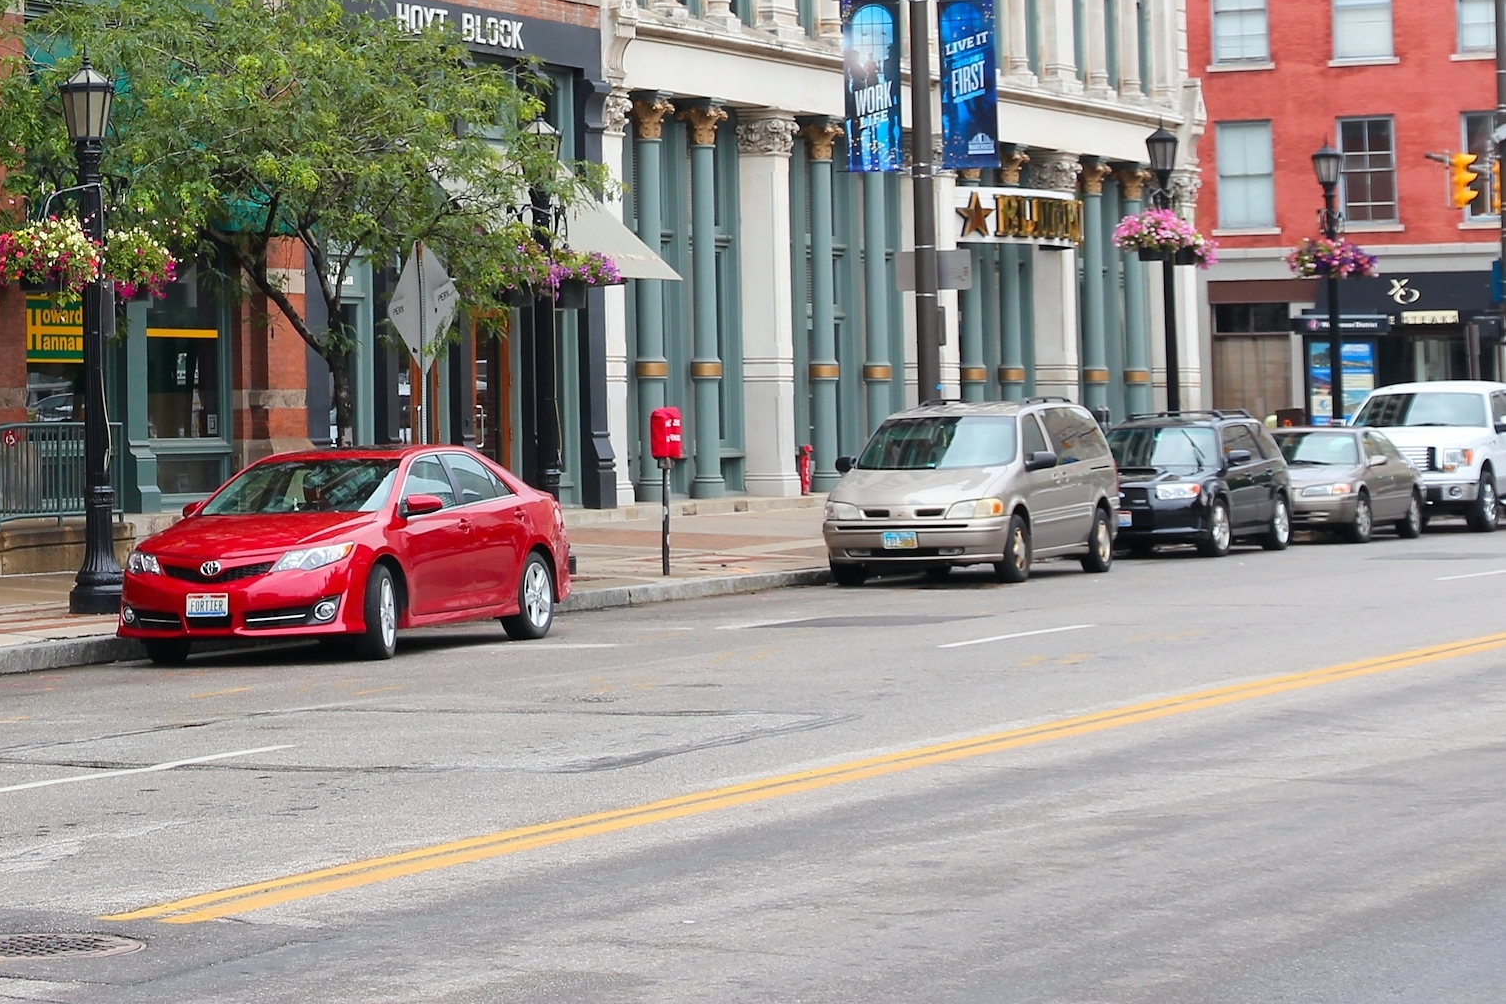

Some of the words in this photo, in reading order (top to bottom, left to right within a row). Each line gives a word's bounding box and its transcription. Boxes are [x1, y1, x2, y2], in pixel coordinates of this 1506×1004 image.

[396, 2, 449, 36] HOYT
[461, 12, 525, 51] BLOCK
[945, 36, 975, 56] LIVE
[976, 30, 989, 45] IT
[951, 60, 986, 98] FIRST
[854, 80, 892, 117] WORK
[859, 109, 889, 130] LIFE
[1387, 278, 1421, 305] XO
[1321, 321, 1355, 329] Waouse
[1403, 313, 1460, 325] STEAKS
[190, 600, 223, 612] FORTIER
